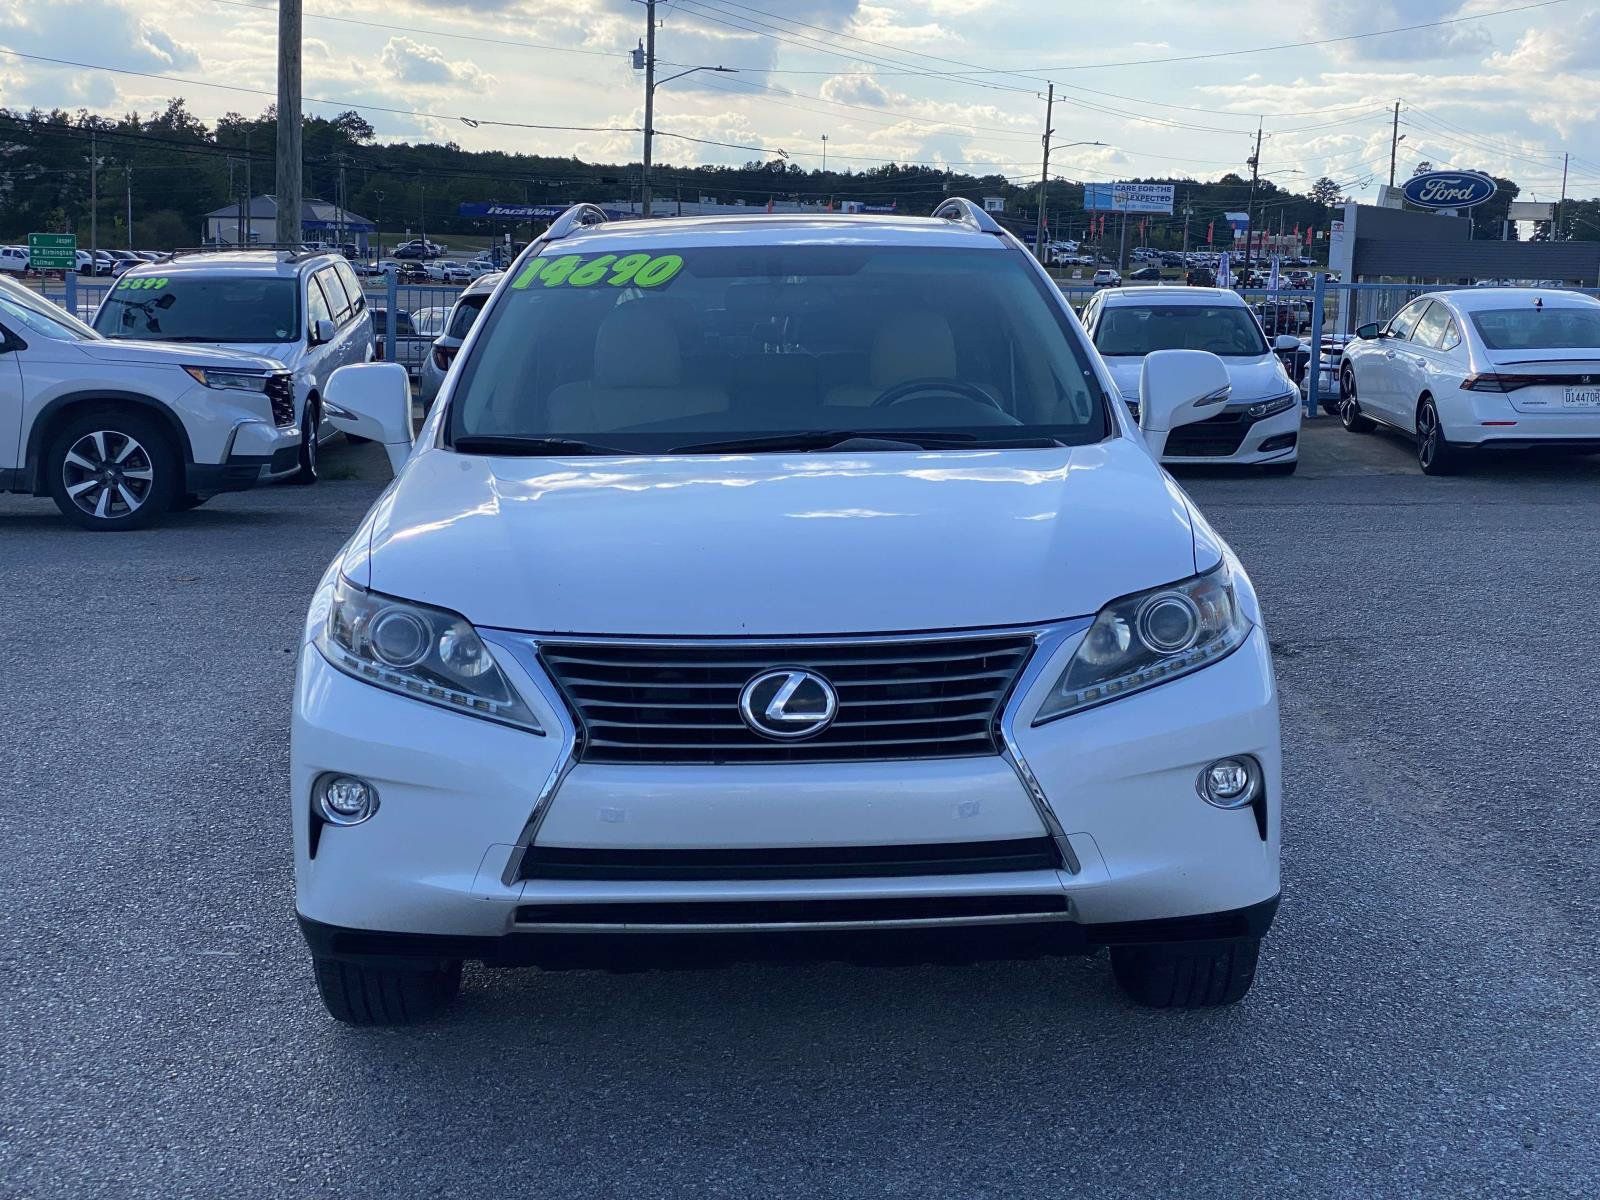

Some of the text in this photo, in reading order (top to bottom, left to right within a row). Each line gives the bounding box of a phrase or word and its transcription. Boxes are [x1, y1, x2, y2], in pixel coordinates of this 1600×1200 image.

[1419, 178, 1476, 201] Ford
[55, 237, 73, 245] Jasper
[42, 248, 73, 256] Birmingham
[511, 253, 685, 289] 14690
[117, 277, 169, 290] 5899
